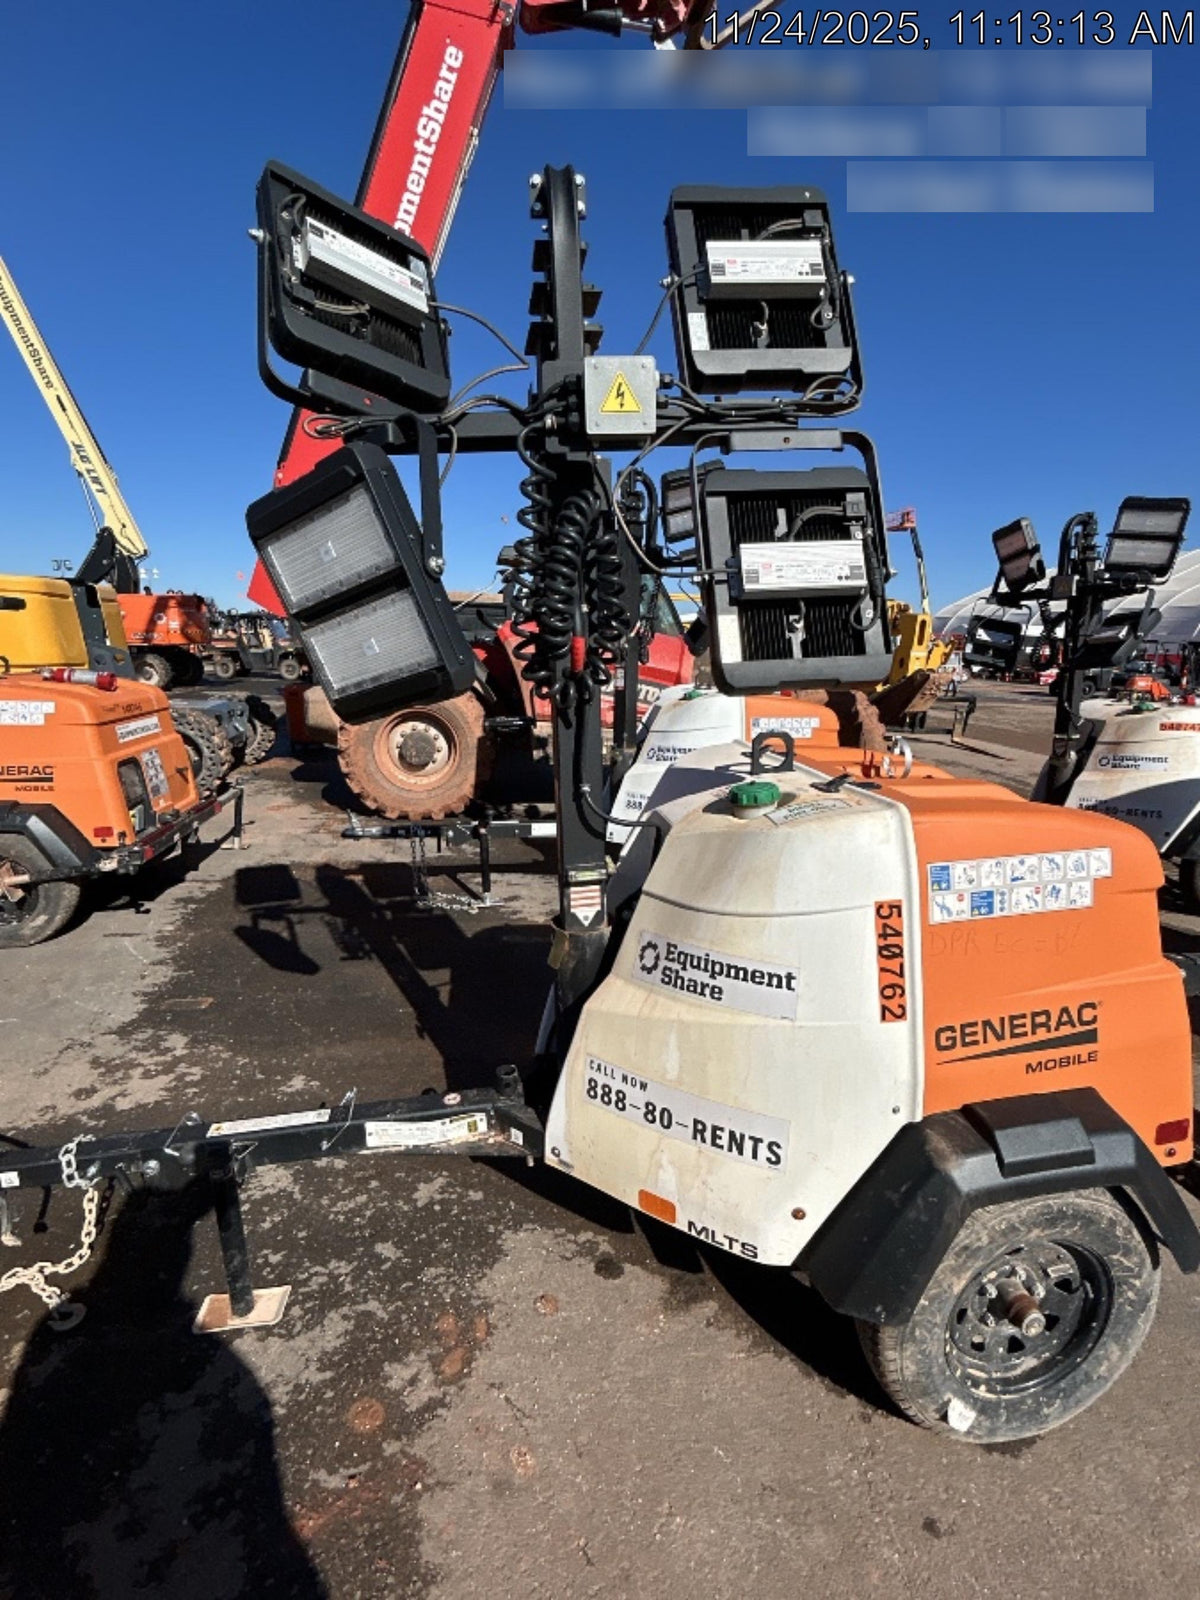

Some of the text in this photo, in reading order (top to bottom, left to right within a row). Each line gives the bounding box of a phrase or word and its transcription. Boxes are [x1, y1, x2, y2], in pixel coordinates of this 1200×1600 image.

[660, 967, 724, 1001] Share
[664, 942, 797, 991] Equipment
[876, 903, 906, 1021] 540762
[935, 1002, 1098, 1052] GENERAC
[588, 1059, 649, 1093] CALL NOW
[1025, 1051, 1099, 1075] MOBILE
[586, 1077, 783, 1167] 888-80-RENTS
[687, 1220, 758, 1259] MLTS
